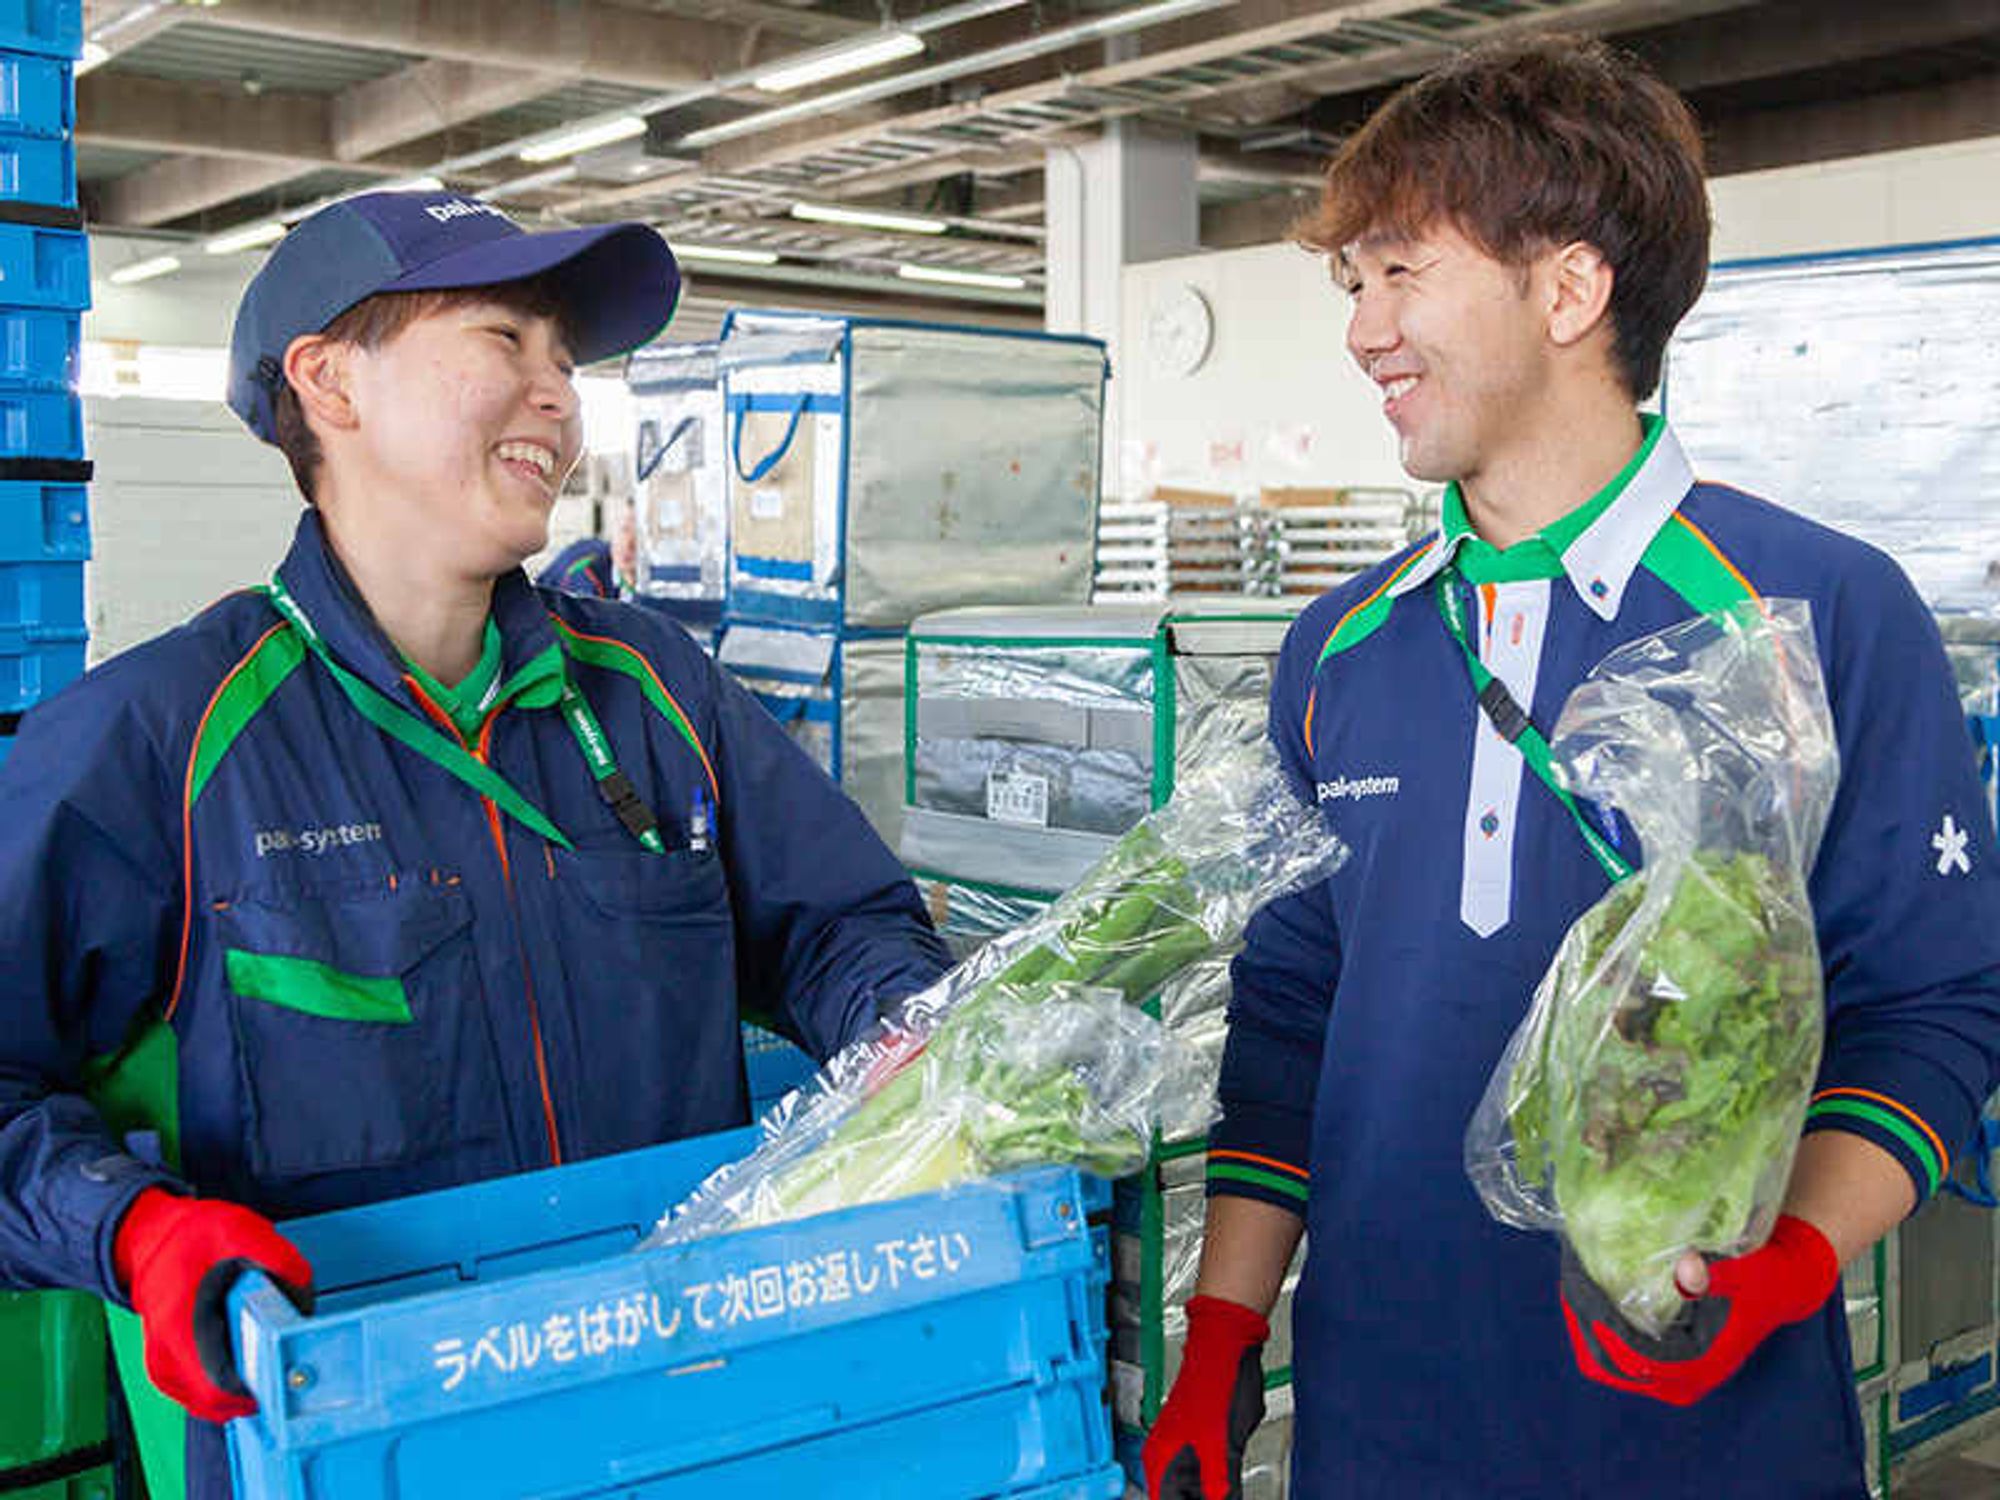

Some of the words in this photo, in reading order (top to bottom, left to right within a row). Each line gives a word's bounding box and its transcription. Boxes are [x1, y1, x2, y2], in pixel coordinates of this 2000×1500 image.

[433, 1231, 972, 1391] ラベルをはがして次回お返し下さい
